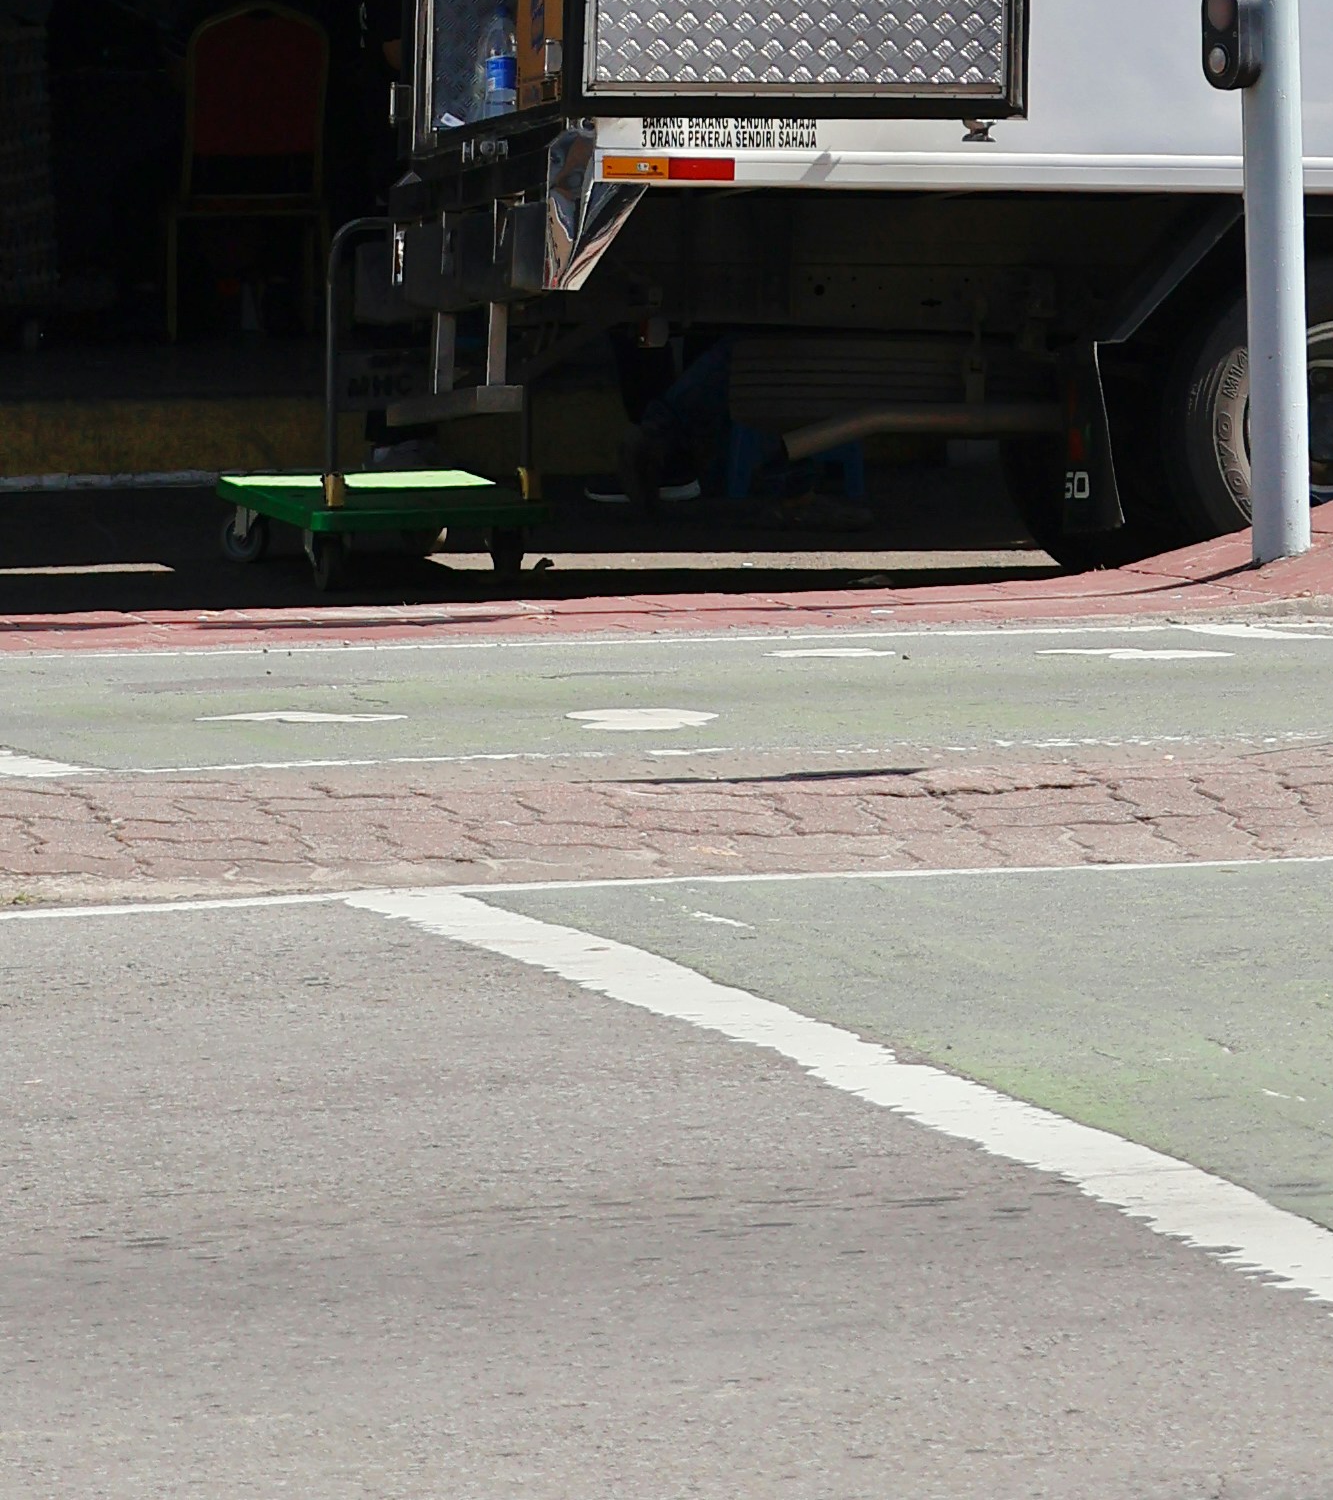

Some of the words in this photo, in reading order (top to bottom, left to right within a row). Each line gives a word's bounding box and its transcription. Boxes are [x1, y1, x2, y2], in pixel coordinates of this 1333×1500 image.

[641, 130, 648, 148] 3
[649, 129, 685, 148] ORANG
[688, 130, 733, 148] PEKERJA
[735, 130, 776, 148] SENDIRI
[778, 130, 818, 149] SAHAJA
